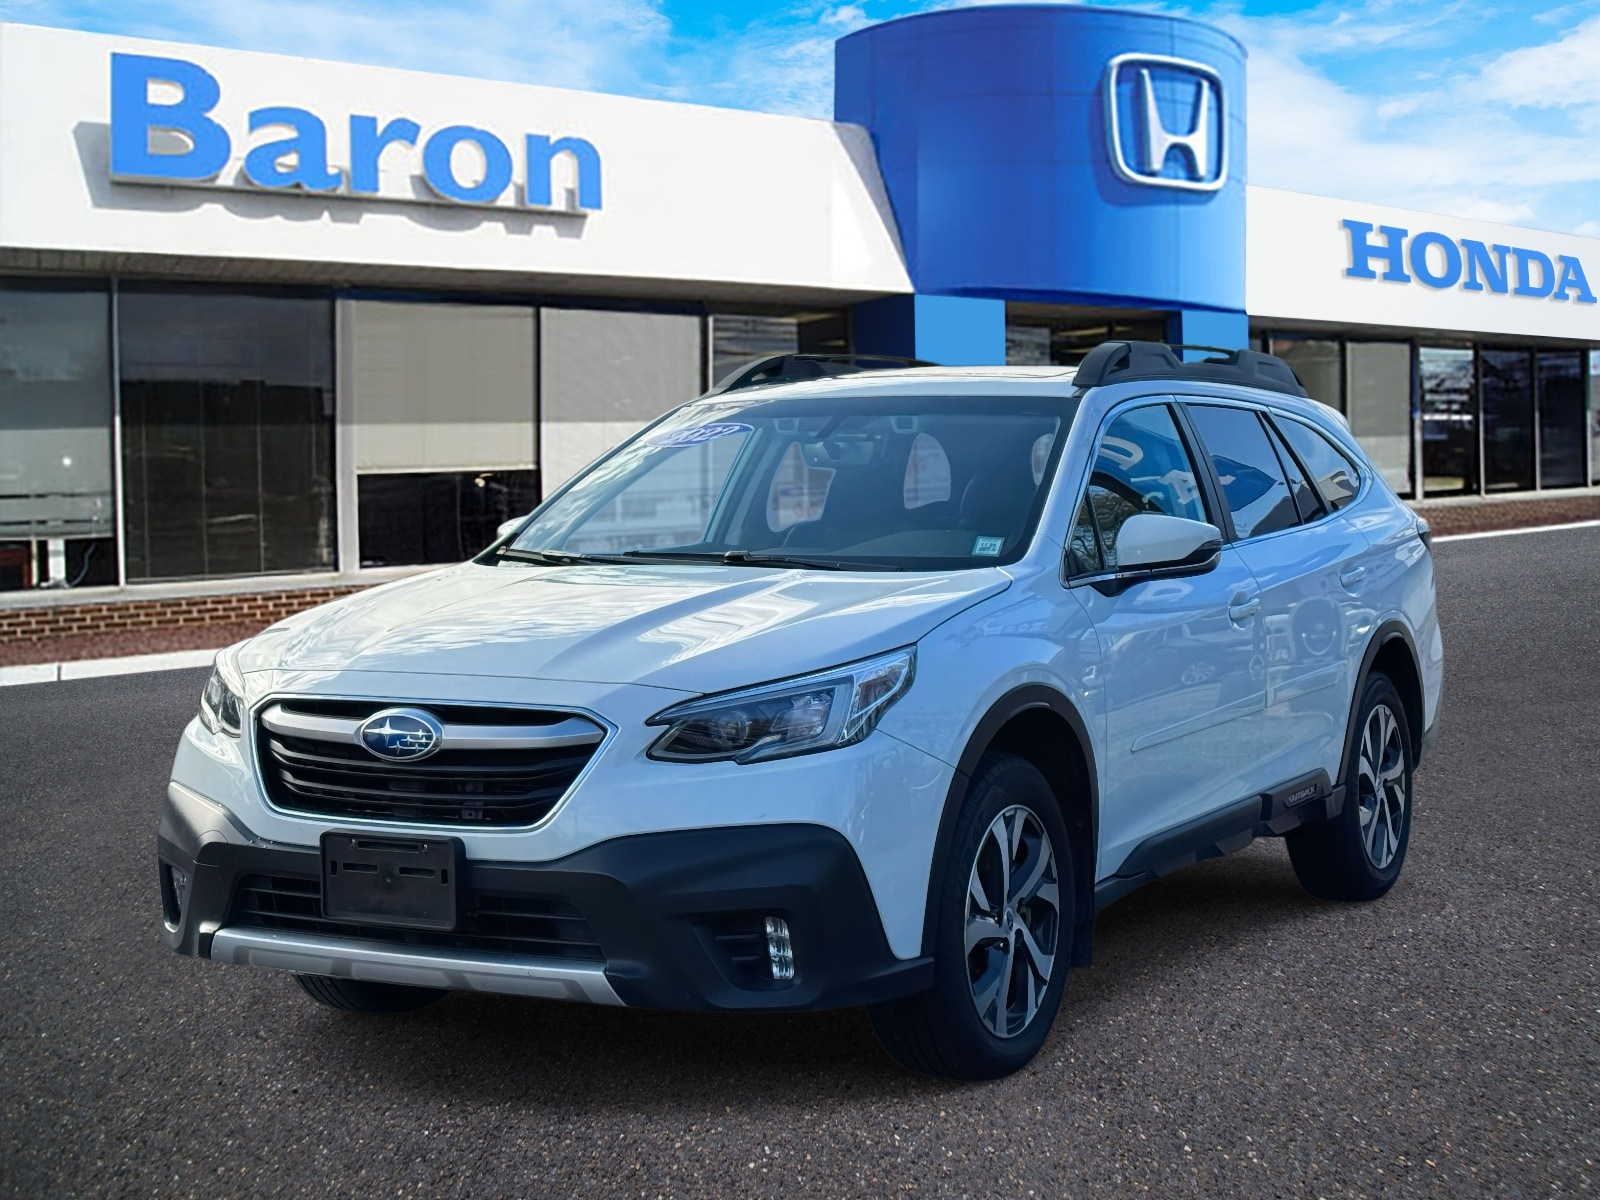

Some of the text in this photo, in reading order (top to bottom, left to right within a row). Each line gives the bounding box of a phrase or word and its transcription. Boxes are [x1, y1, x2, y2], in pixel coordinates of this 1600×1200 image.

[110, 52, 603, 211] Baron
[1342, 218, 1598, 304] HONDA
[1288, 786, 1315, 803] OUTBACK
